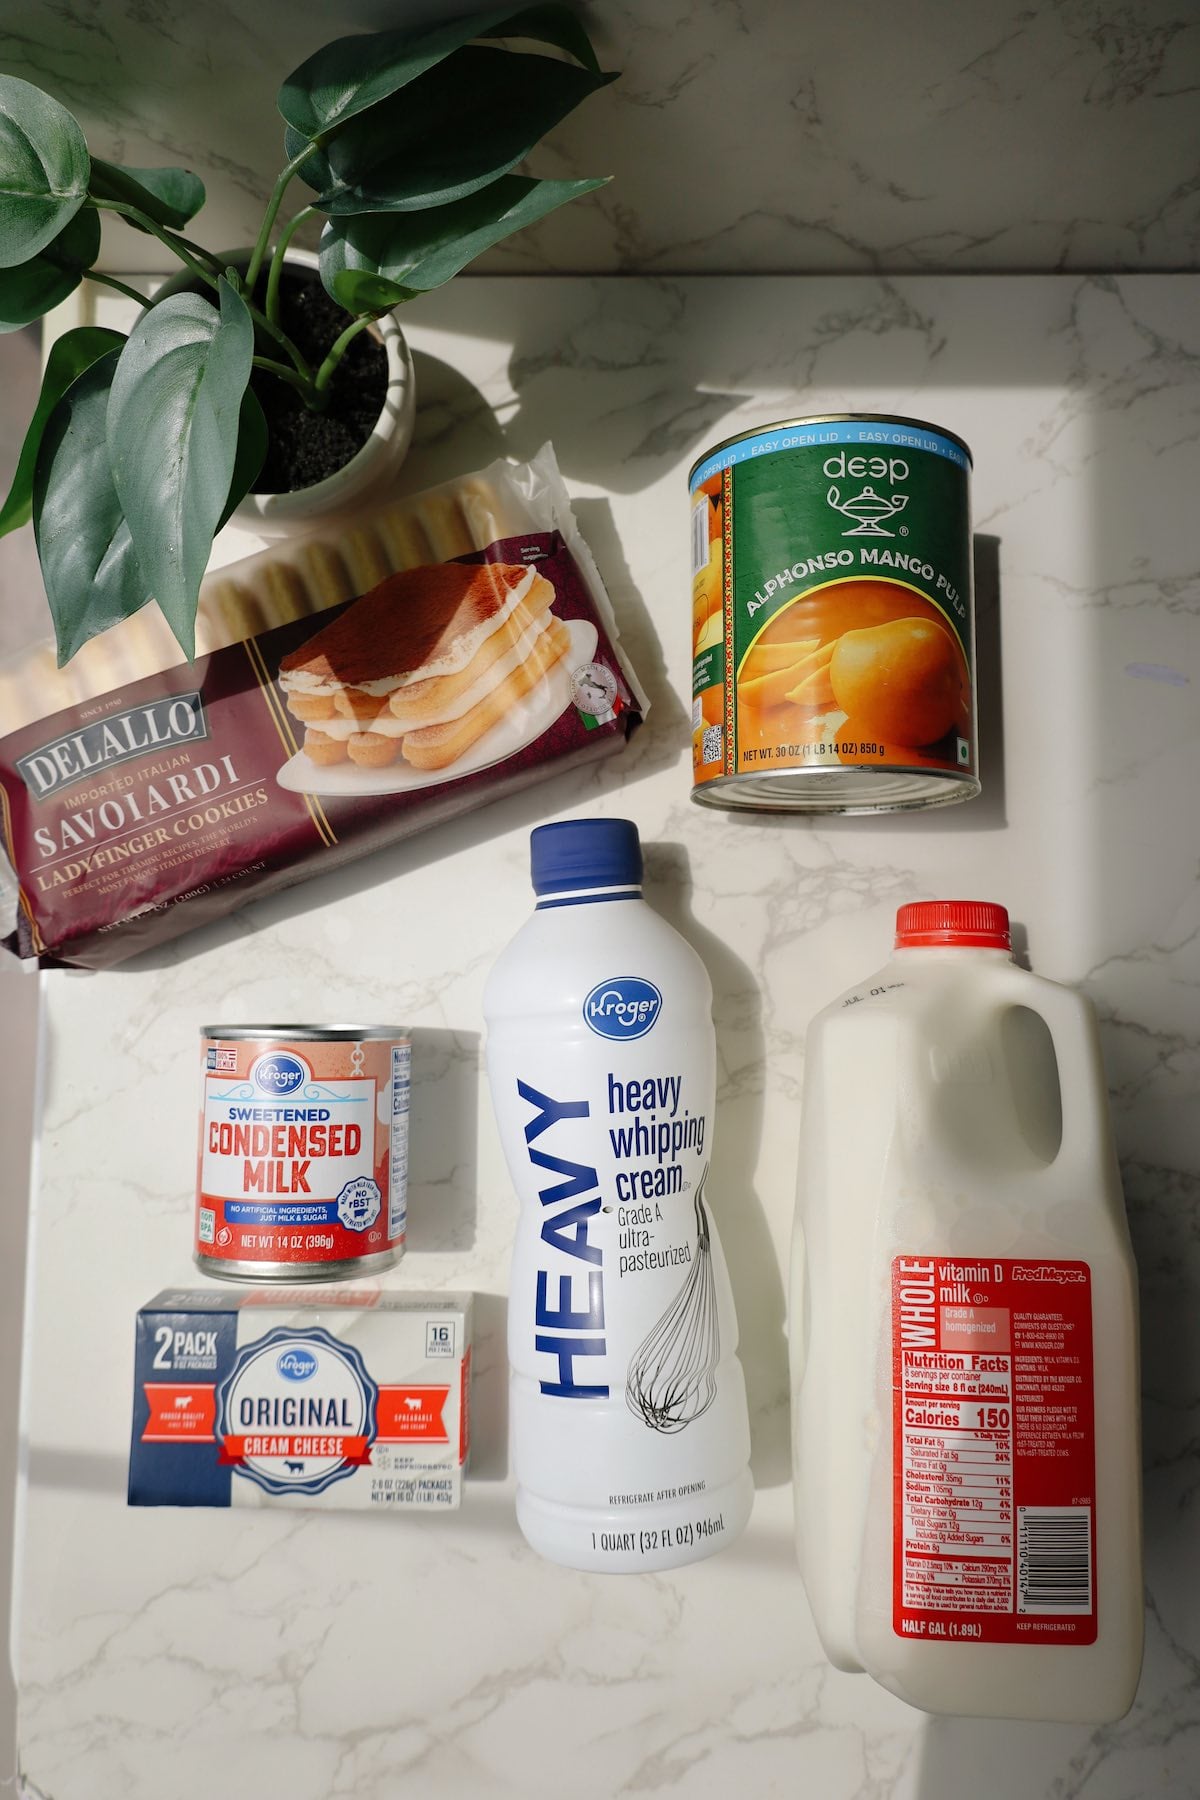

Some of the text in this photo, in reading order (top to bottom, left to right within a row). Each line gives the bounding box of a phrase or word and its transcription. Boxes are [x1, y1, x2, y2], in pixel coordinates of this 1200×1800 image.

[723, 455, 736, 468] LID
[751, 442, 778, 456] EASY
[782, 434, 815, 448] OPEN
[820, 432, 838, 443] LID
[859, 432, 889, 443] EASY
[892, 433, 922, 447] OPEN
[924, 441, 938, 452] LID
[823, 451, 909, 485] deep
[746, 549, 966, 618] ALPHONSO MANGO PULP
[25, 700, 199, 792] DELALLO
[743, 743, 885, 762] NET WT. 30 OZ (1 LB 14 OZ) 850 g
[64, 753, 191, 810] IMPORTED ITALIAN
[33, 754, 241, 858] SAVOIARDI
[38, 788, 269, 892] LADYFINGER COOKIES
[63, 816, 258, 898] PERFECT FOR TIRAMISU RECIPES, THE WORLD'S
[98, 837, 231, 895] MOST FAMOUS ITALIAN DESSERT
[591, 990, 658, 1026] Kroger
[842, 996, 864, 1007] JUL
[259, 1064, 300, 1087] Kroger
[608, 1073, 682, 1118] heavy
[229, 1108, 330, 1121] SWEETENED
[209, 1121, 361, 1157] CONDENSED
[609, 1110, 705, 1164] whipping
[244, 1160, 311, 1193] MILK
[616, 1164, 683, 1202] cream
[349, 1198, 370, 1208] rBST
[618, 1202, 663, 1226] Grade A
[242, 1234, 334, 1250] NET WT 14 OZ (396g)
[516, 1078, 610, 1399] HEAVY
[619, 1228, 655, 1249] ultra-
[620, 1241, 692, 1278] pasteurized
[939, 1263, 1003, 1282] vitamin D
[940, 1284, 971, 1303] milk
[900, 1260, 936, 1348] WHOLE
[945, 1308, 967, 1318] Grade
[432, 1328, 448, 1340] 16
[946, 1321, 996, 1334] homogenized
[153, 1327, 217, 1369] 2 PACK
[280, 1354, 316, 1375] Kroger
[904, 1352, 1008, 1371] Nutrition Facts
[911, 1370, 937, 1380] servings
[940, 1372, 950, 1380] per
[905, 1380, 932, 1392] Serving
[935, 1382, 950, 1391] size
[978, 1384, 1008, 1396] (240mL)
[240, 1398, 353, 1427] ORIGINAL
[906, 1399, 960, 1410] Amount per serving
[395, 1414, 433, 1422] SPREADABLE
[906, 1408, 1009, 1428] Calories 150
[244, 1437, 344, 1455] CREAM CHEESE
[906, 1436, 922, 1444] Total
[925, 1437, 935, 1445] Fat
[911, 1447, 949, 1458] Saturated Fat
[385, 1480, 452, 1489] OZ PACKAGES
[906, 1471, 944, 1481] Cholesterol
[609, 1480, 706, 1505] REFRIGERATE AFTER OPENING
[906, 1482, 930, 1491] Sodium
[372, 1492, 383, 1501] NET
[386, 1492, 395, 1501] WT
[406, 1492, 414, 1501] OZ
[906, 1494, 922, 1503] Total
[925, 1494, 969, 1507] Carbohydrate
[972, 1500, 982, 1510] 12g
[911, 1506, 930, 1516] Dietary
[933, 1508, 947, 1517] Fiber
[927, 1519, 947, 1530] Sugars
[949, 1521, 959, 1532] 12g
[601, 1532, 635, 1551] QUART
[640, 1531, 658, 1554] (32
[662, 1530, 673, 1548] FL
[676, 1523, 694, 1546] OZ)
[906, 1541, 930, 1550] Protein
[902, 1619, 981, 1638] HALF GAL (1.89L)
